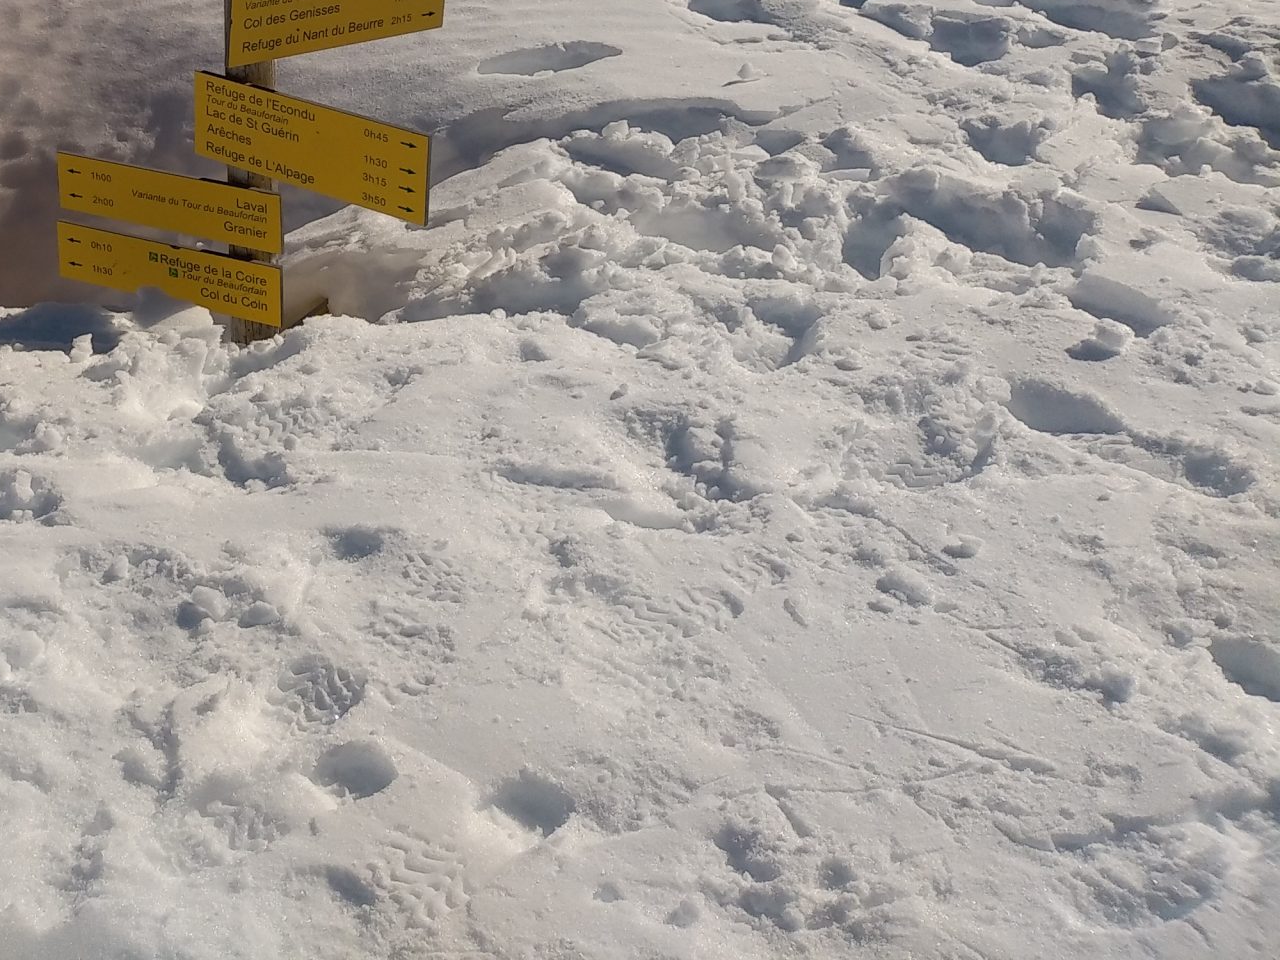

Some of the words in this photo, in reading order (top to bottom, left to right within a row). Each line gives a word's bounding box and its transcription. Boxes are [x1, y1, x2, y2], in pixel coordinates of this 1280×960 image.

[242, 35, 282, 53] Refuge
[285, 32, 300, 45] du
[303, 27, 329, 42] Nant
[331, 23, 345, 37] du
[348, 17, 384, 34] Beurre
[390, 13, 412, 26] 2h15
[244, 18, 263, 30] Col
[266, 13, 286, 26] des
[289, 3, 341, 22] Genisses
[206, 81, 246, 102] Refuge
[249, 93, 263, 107] de
[266, 97, 316, 122] l'Econdu
[206, 95, 224, 106] Tour
[227, 100, 238, 110] du
[240, 104, 289, 126] Beaufortain
[206, 106, 226, 120] Lac
[228, 111, 243, 126] de
[246, 117, 258, 131] St
[261, 121, 300, 143] Guérin
[363, 128, 389, 143] 0h45
[207, 123, 252, 146] Arêches
[362, 172, 387, 187] 3h15
[363, 155, 388, 169] 1h30
[90, 171, 112, 182] 1h00
[236, 198, 268, 214] Laval
[206, 141, 245, 162] Refuge
[248, 154, 263, 168] de
[266, 160, 315, 185] L'Alpage
[361, 192, 387, 207] 3h50
[92, 196, 114, 207] 2h00
[223, 221, 268, 239] Granier
[131, 189, 166, 203] Variante
[168, 196, 179, 206] du
[182, 199, 202, 211] Tour
[203, 202, 215, 213] du
[217, 206, 267, 224] Beaufortain
[90, 240, 113, 253] 0h10
[160, 254, 201, 274] Refuge
[203, 263, 219, 276] de
[221, 265, 232, 279] la
[235, 270, 268, 287] Coire
[92, 264, 113, 276] 1h30
[182, 271, 202, 282] Tour
[203, 275, 215, 285] du
[217, 278, 267, 297] Beaufortain
[200, 286, 220, 300] Col
[223, 291, 238, 304] du
[240, 296, 268, 312] Coin
